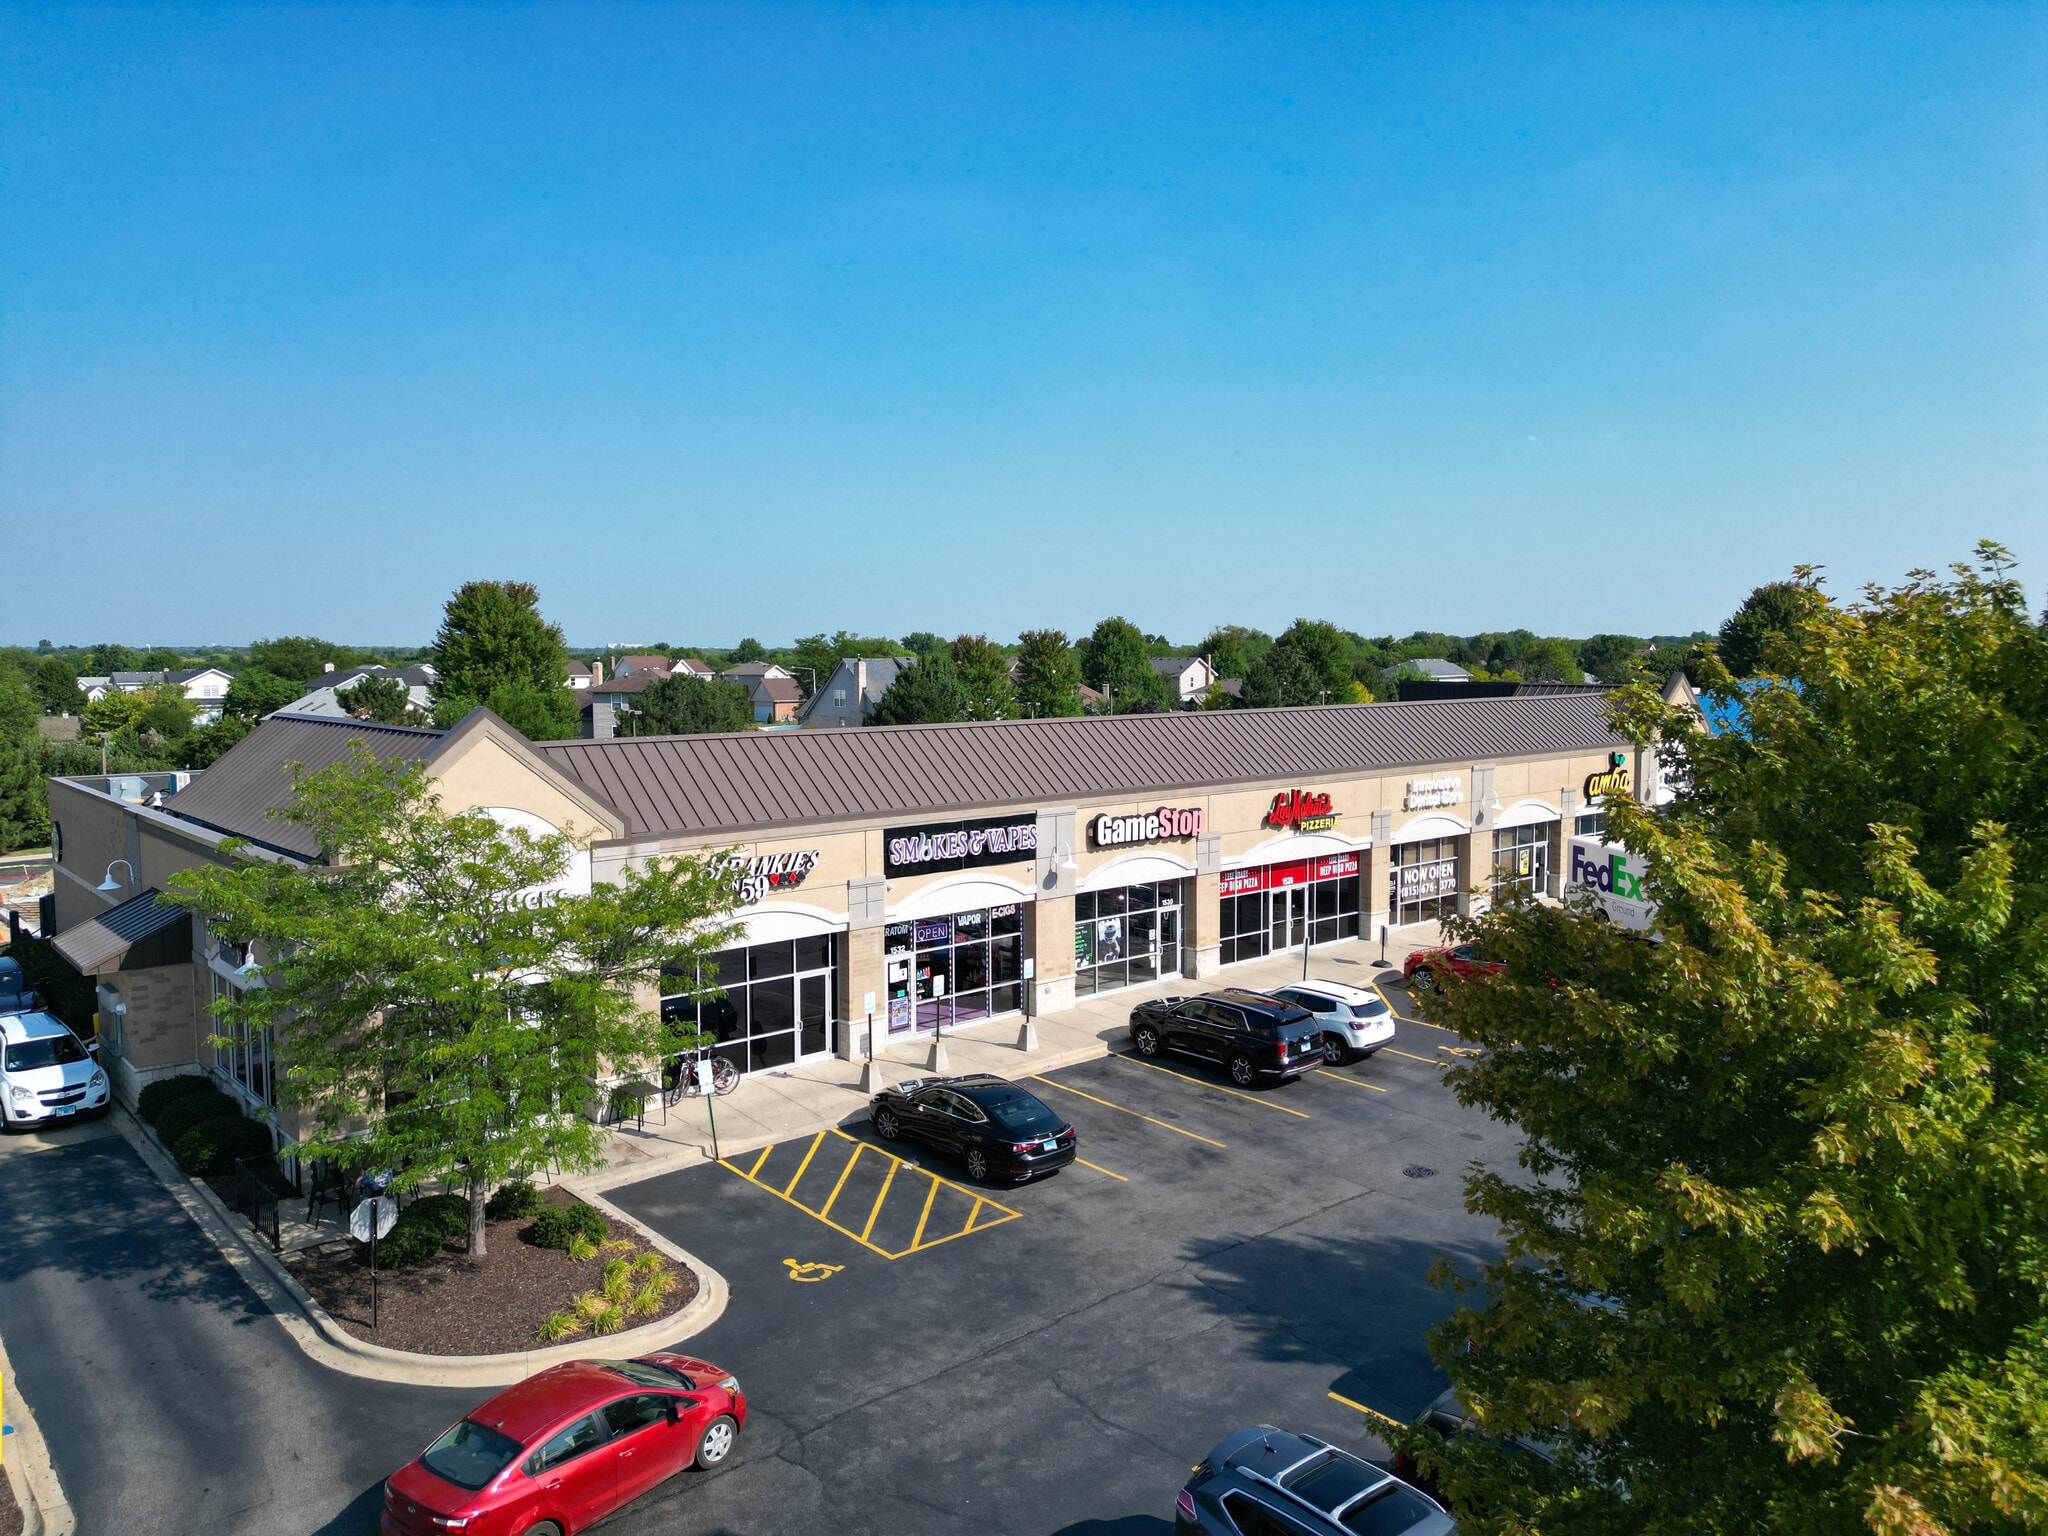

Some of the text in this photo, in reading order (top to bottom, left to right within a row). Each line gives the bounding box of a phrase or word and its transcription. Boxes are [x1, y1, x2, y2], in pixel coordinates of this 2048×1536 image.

[1097, 808, 1206, 846] GameStop
[1301, 817, 1339, 831] PIZZERIA
[890, 824, 1038, 865] SMOKES & VAPES
[1345, 861, 1358, 873] PIZZA
[1404, 862, 1454, 885] NOW OPEN
[1572, 844, 1644, 902] FedEx
[740, 875, 769, 900] 59
[1244, 877, 1258, 889] PIZZA
[1401, 884, 1419, 898] (815)
[991, 904, 1016, 919] E-CIGS
[1612, 901, 1635, 917] Ground
[957, 913, 982, 927] VAPOR
[917, 926, 945, 941] OPEN
